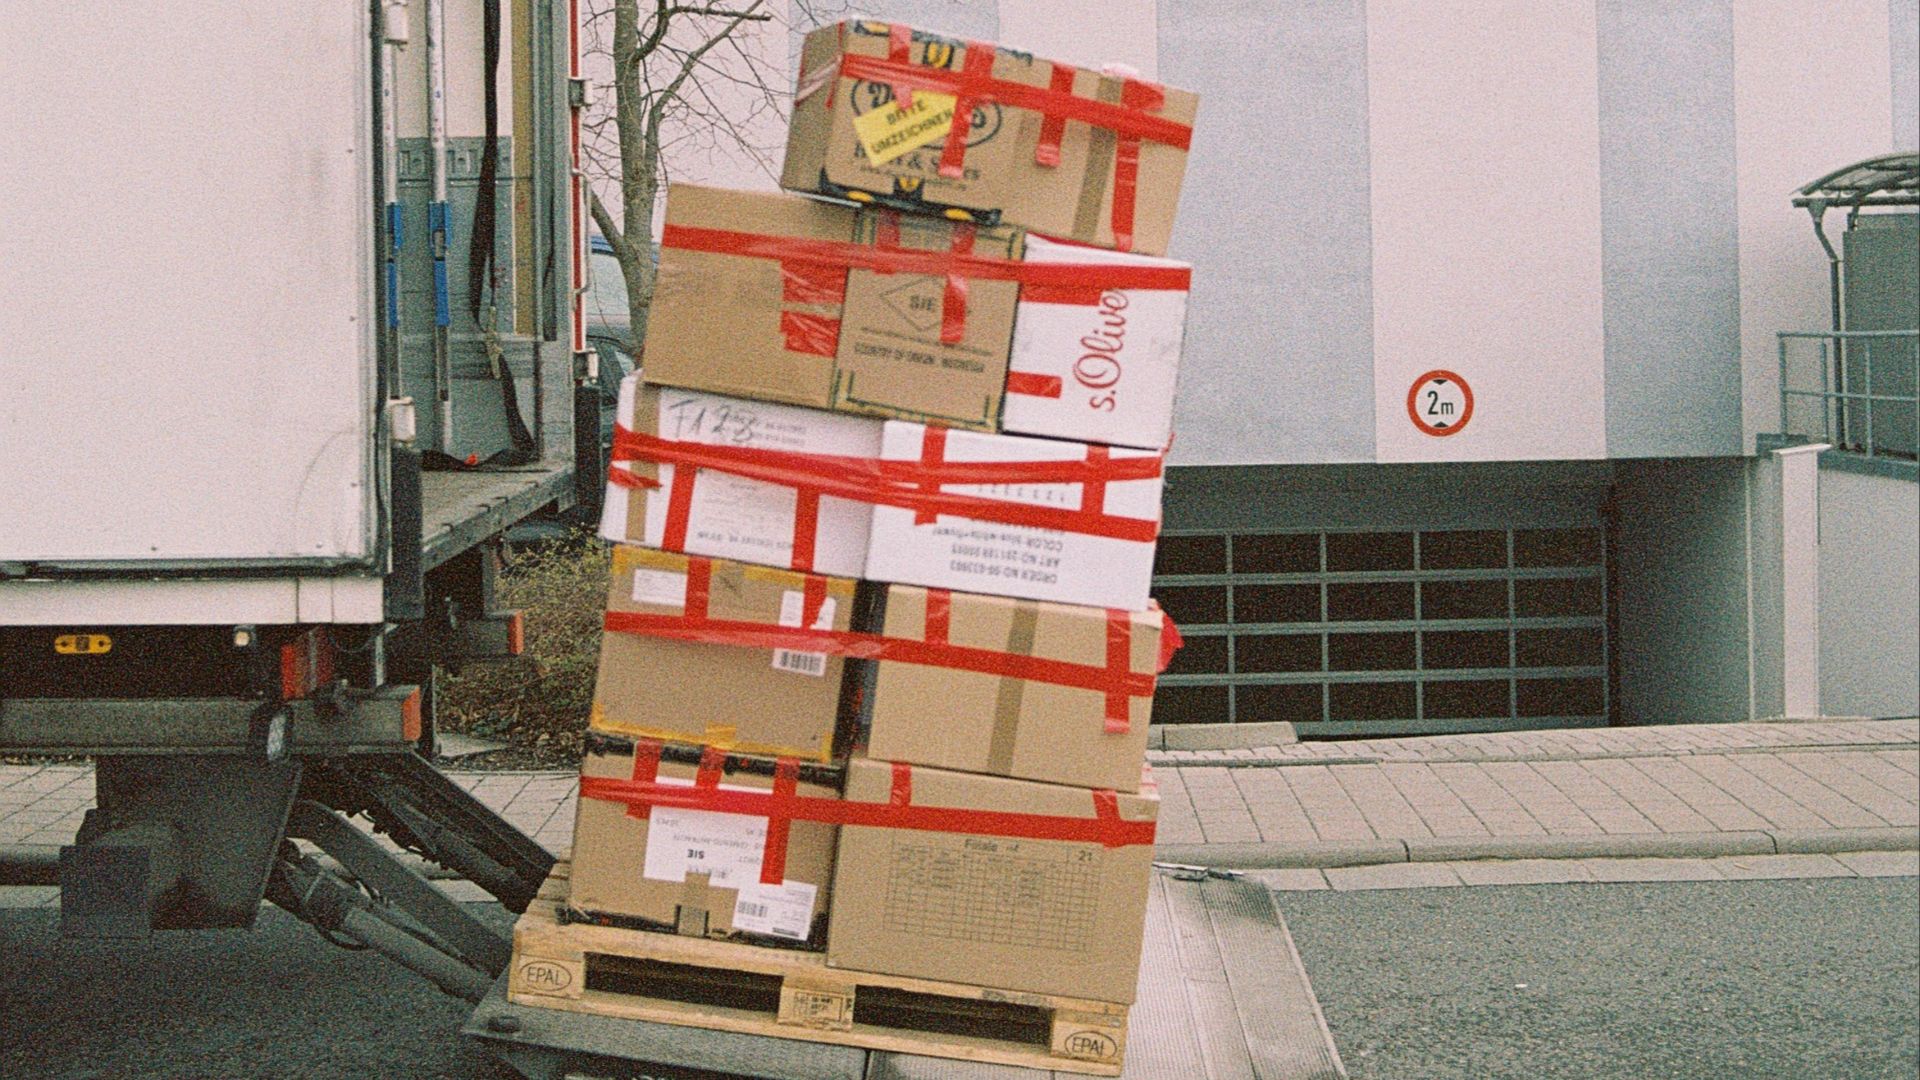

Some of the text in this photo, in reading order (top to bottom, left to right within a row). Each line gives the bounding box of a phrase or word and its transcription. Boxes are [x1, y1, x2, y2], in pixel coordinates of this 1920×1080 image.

[1073, 291, 1129, 411] s.Olive
[686, 847, 705, 859] SIE
[526, 966, 561, 985] EPAL
